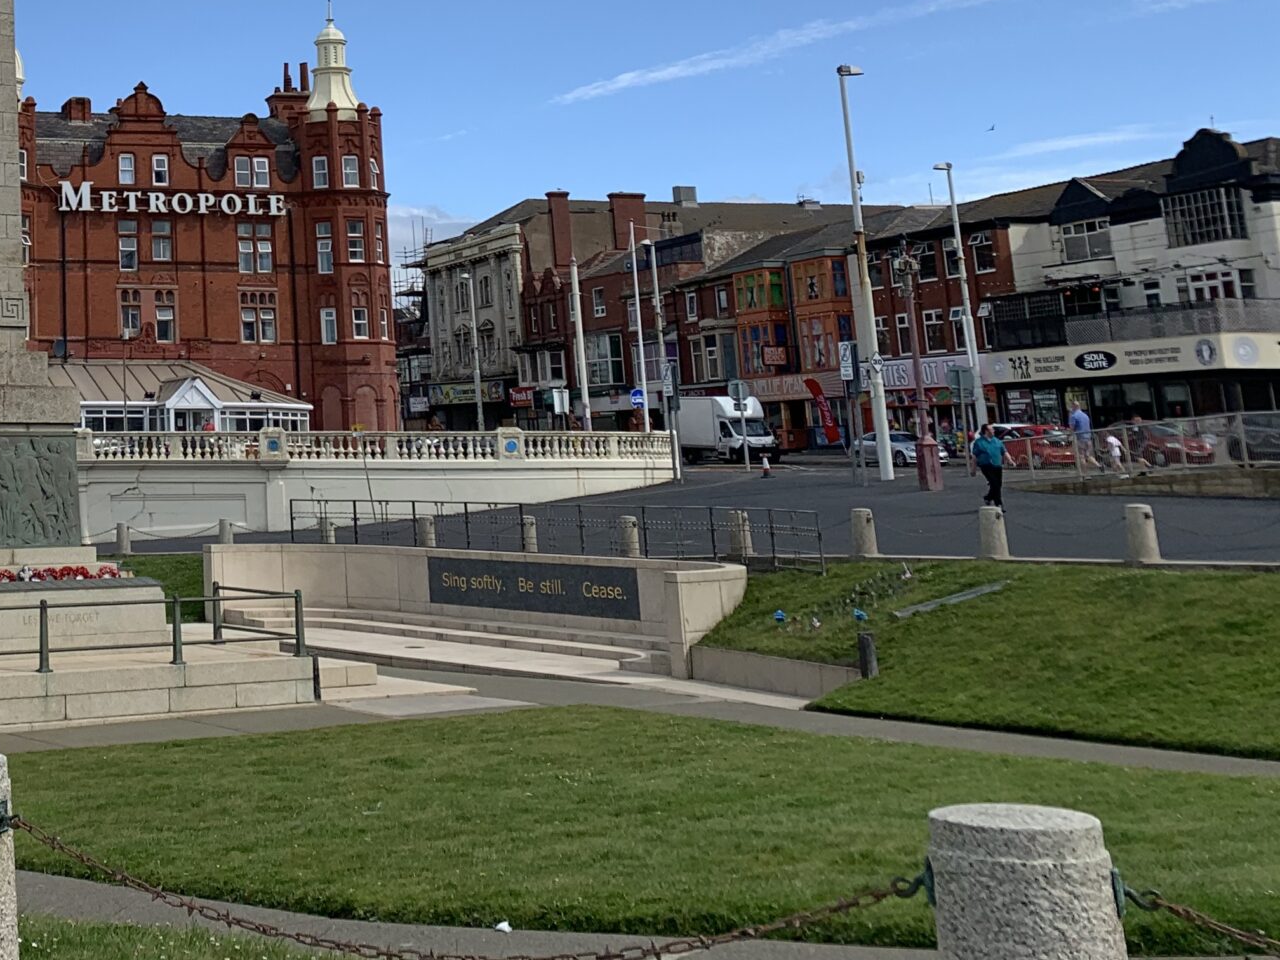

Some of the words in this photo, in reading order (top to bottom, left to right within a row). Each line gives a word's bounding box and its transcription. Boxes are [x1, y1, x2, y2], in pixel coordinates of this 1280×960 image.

[57, 180, 287, 216] METROPOLE
[1083, 353, 1106, 361] SOUL
[1083, 360, 1108, 369] SUITE
[442, 572, 467, 591] Sing
[471, 574, 506, 594] softly.
[518, 577, 534, 593] Be
[540, 579, 566, 596] still.
[582, 581, 627, 600] Cease.
[65, 612, 99, 624] FORGET
